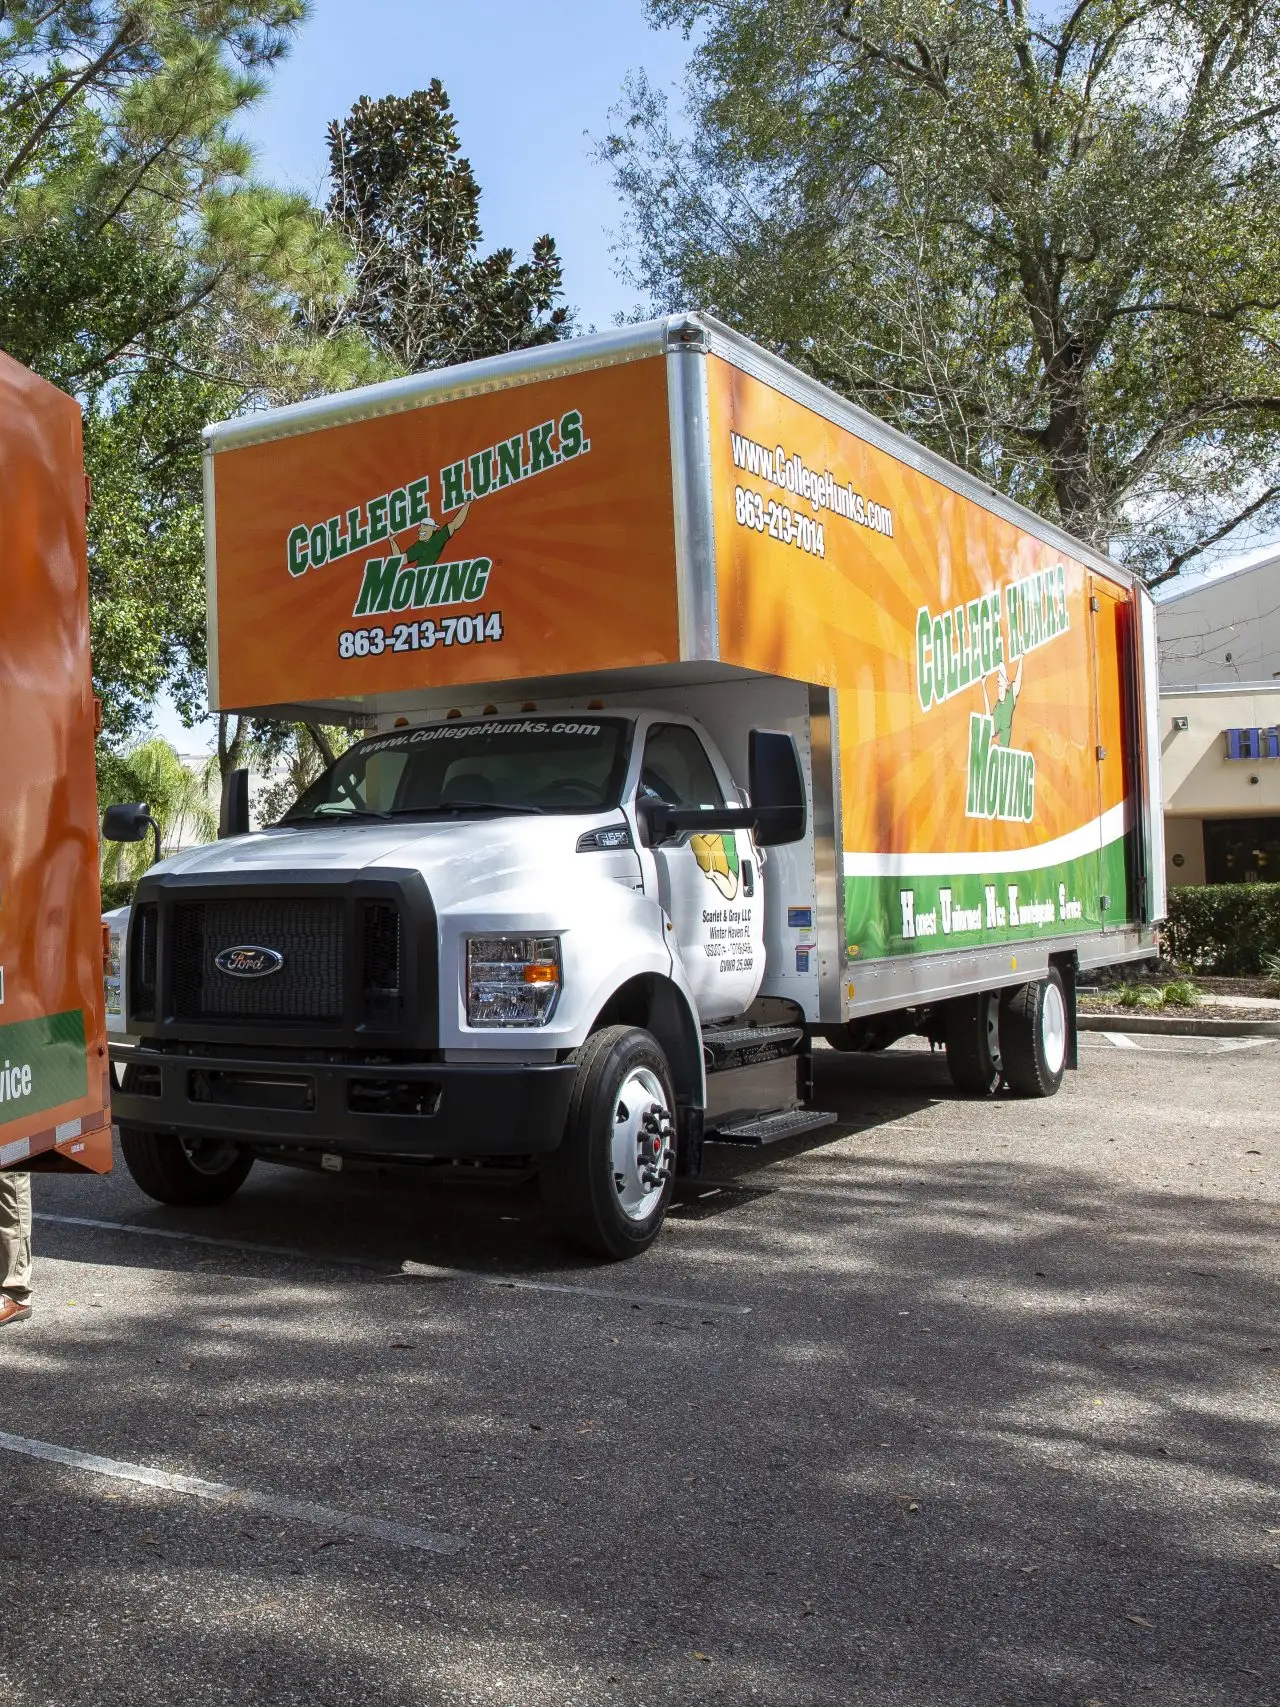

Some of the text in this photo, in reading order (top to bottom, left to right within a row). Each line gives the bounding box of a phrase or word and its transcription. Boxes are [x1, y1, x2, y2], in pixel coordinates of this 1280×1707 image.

[287, 408, 591, 578] COLLEGE H.U.N.K.S.
[734, 484, 826, 559] 863-213-7014
[352, 556, 493, 617] MOVING
[338, 611, 503, 659] 863-213-7014
[916, 588, 1004, 714] COLLEGE
[360, 721, 602, 754] www.CollegeHunks.com
[965, 711, 1036, 824] MOVING
[702, 909, 722, 923] Scarlet
[728, 909, 740, 924] Gray
[741, 908, 752, 922] LLC
[709, 925, 751, 940] Winter Haven FL
[900, 888, 937, 940] Honest
[227, 950, 265, 970] Ford
